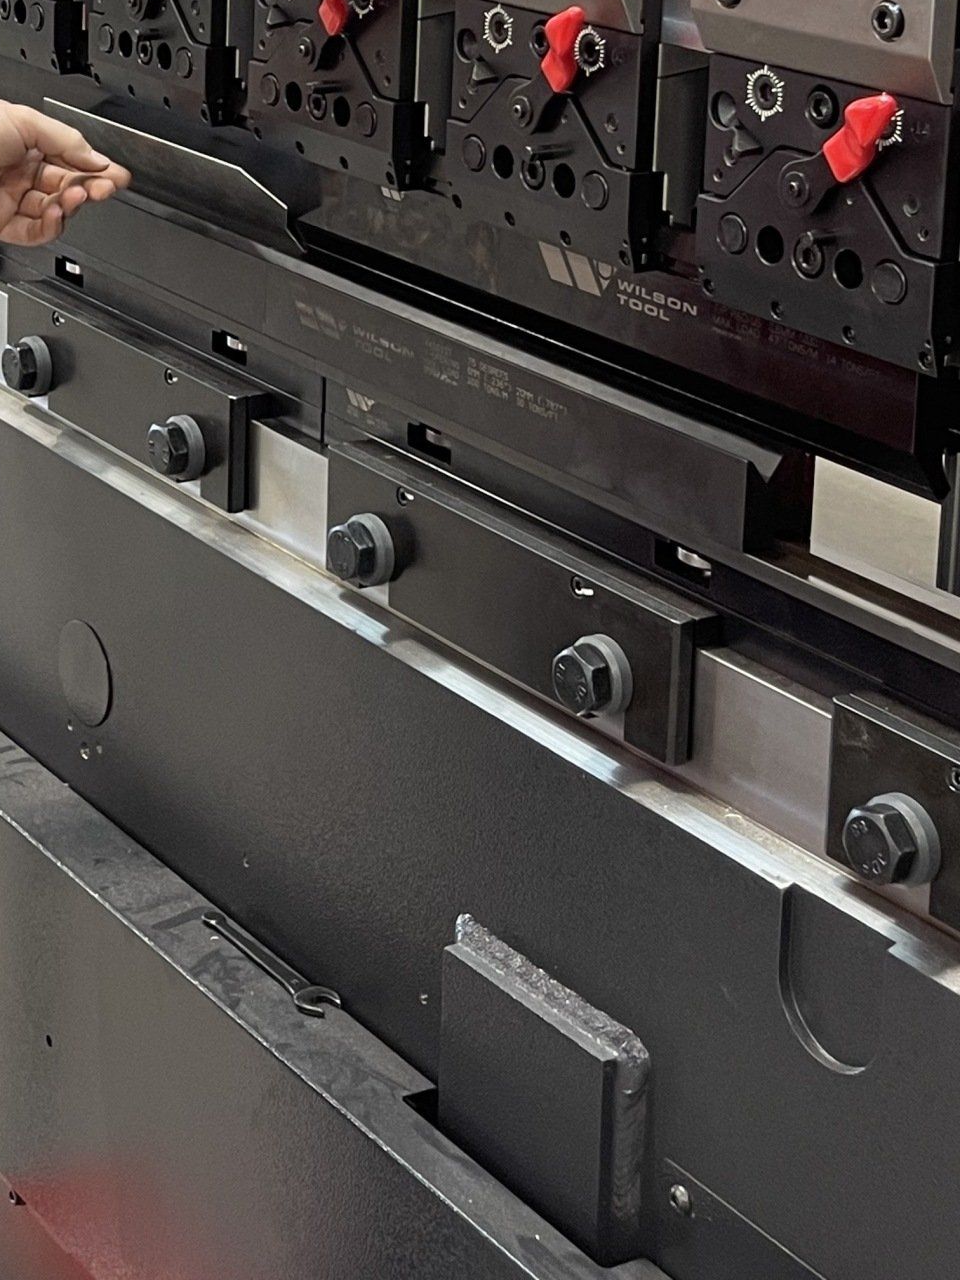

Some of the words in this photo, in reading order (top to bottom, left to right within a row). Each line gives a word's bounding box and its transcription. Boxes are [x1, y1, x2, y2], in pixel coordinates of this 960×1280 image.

[616, 278, 698, 317] WILSON
[616, 293, 671, 322] TOOL
[351, 323, 415, 360] WILSON
